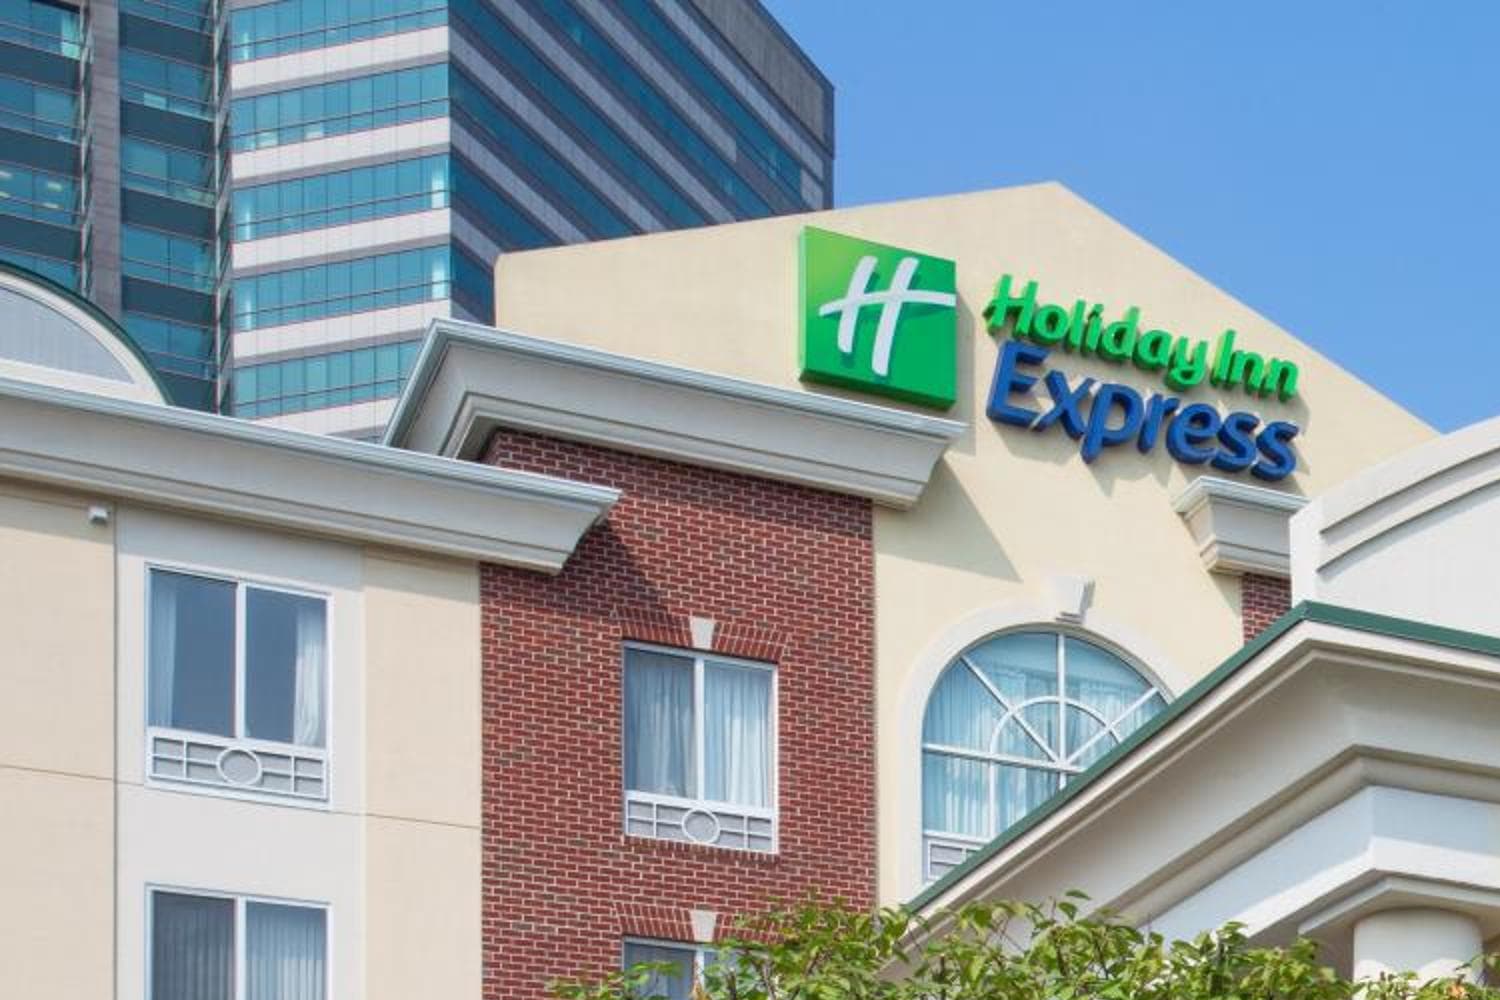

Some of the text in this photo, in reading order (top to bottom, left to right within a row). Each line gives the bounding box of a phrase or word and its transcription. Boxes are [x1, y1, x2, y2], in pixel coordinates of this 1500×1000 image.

[983, 274, 1299, 401] Holiday Inn
[986, 340, 1299, 482] Express
